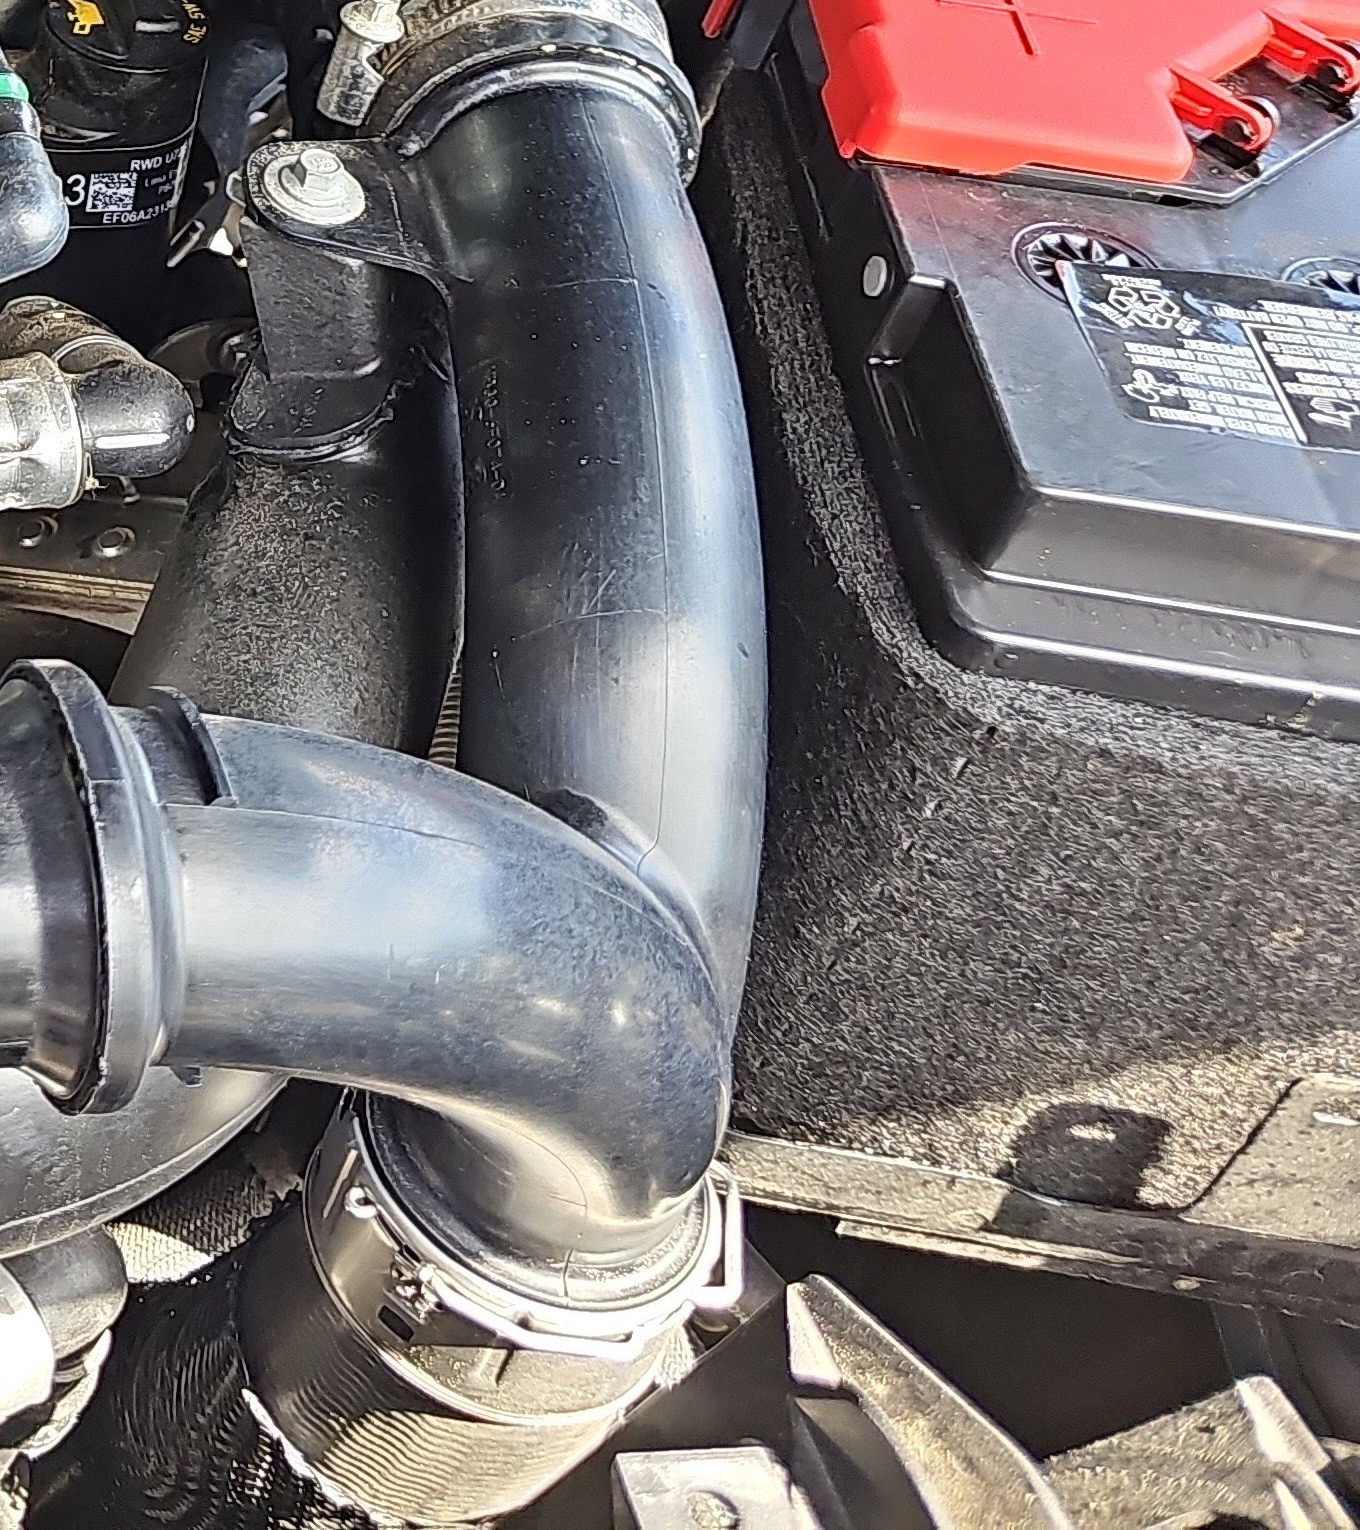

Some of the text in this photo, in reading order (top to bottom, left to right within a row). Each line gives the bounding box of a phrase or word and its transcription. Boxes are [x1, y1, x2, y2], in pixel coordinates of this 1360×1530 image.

[183, 22, 206, 42] SAE
[130, 156, 161, 171] RWD
[62, 172, 88, 208] 3
